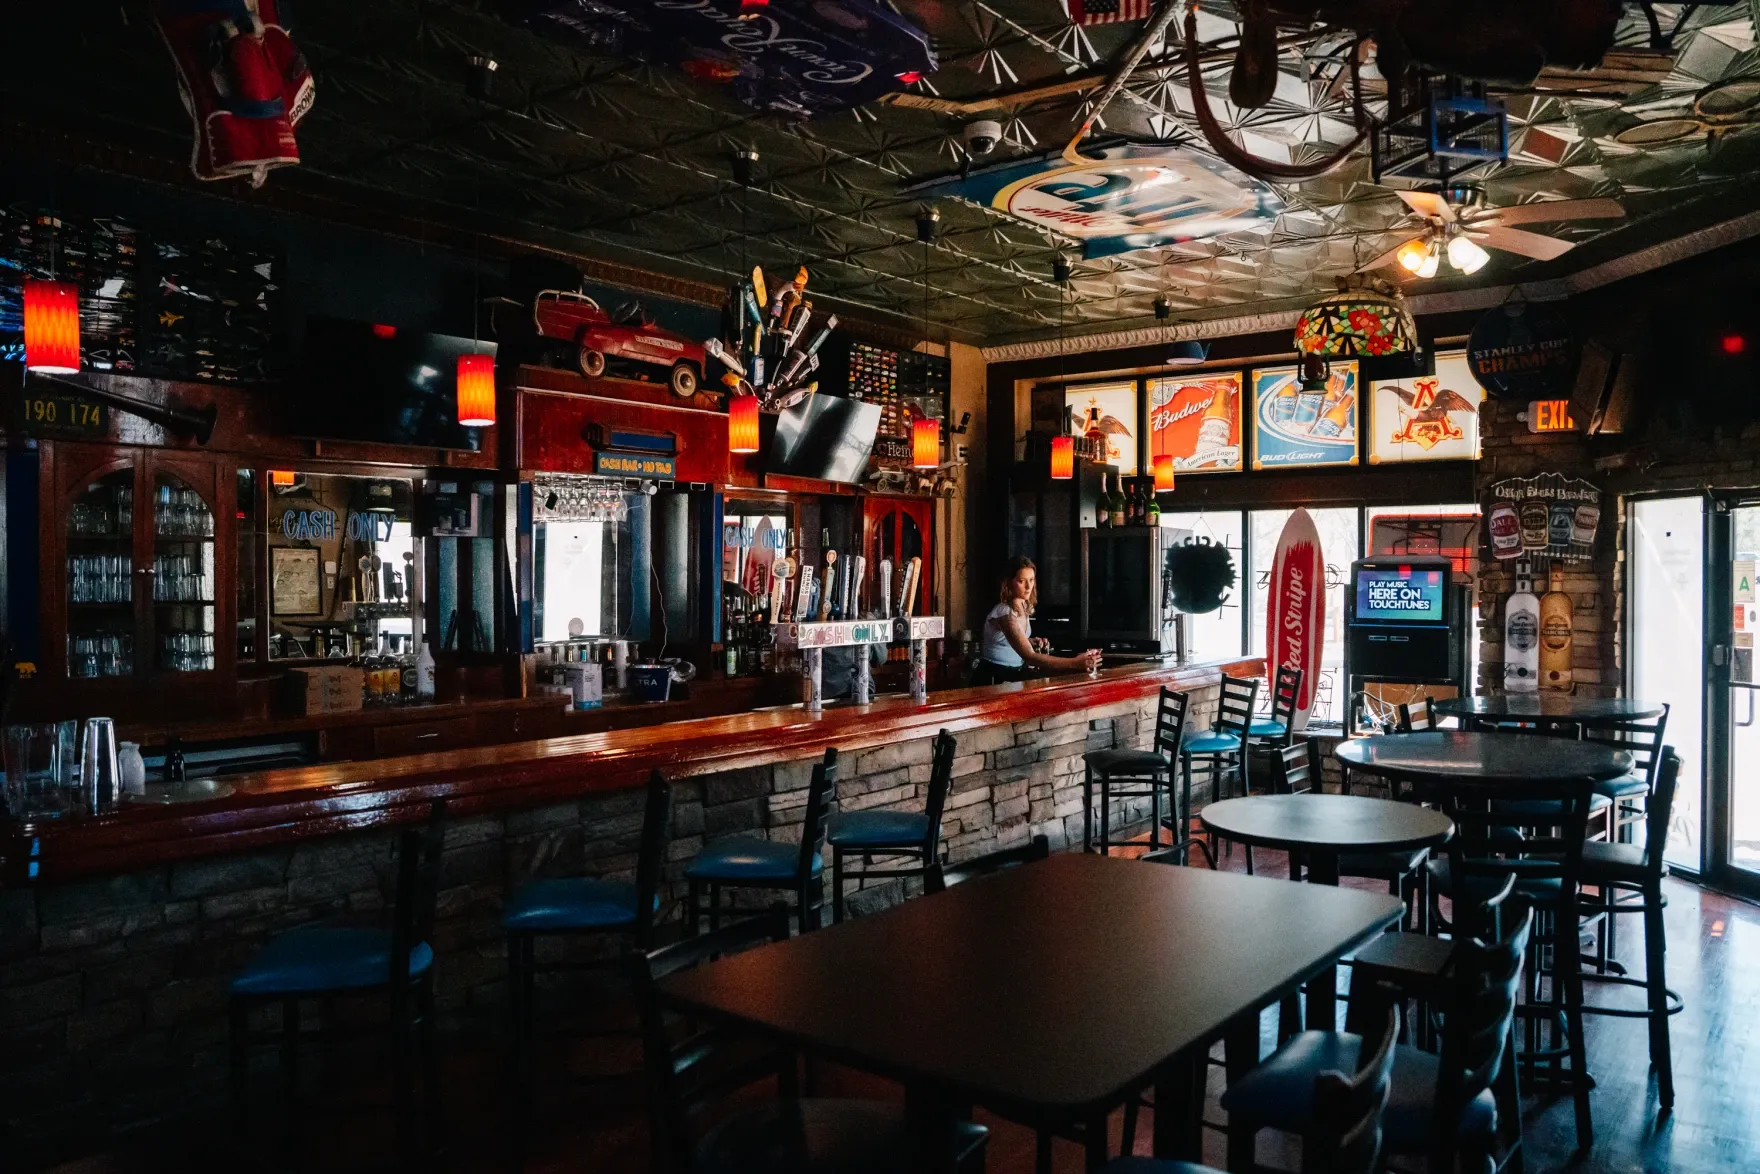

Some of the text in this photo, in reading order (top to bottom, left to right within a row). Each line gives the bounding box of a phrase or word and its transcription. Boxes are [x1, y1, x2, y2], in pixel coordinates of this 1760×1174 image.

[1017, 205, 1113, 228] Miller
[25, 400, 100, 426] 190 174
[1187, 448, 1236, 467] American Lager
[1288, 452, 1325, 461] LIGHT
[283, 510, 396, 542] CASH ONLY
[725, 527, 787, 548] CASH ONLY
[1739, 576, 1750, 591] A
[1284, 566, 1307, 634] Stripe
[1369, 588, 1421, 600] HERE ON
[1369, 600, 1430, 610] TOUCHTUNES
[852, 623, 889, 643] ONLY
